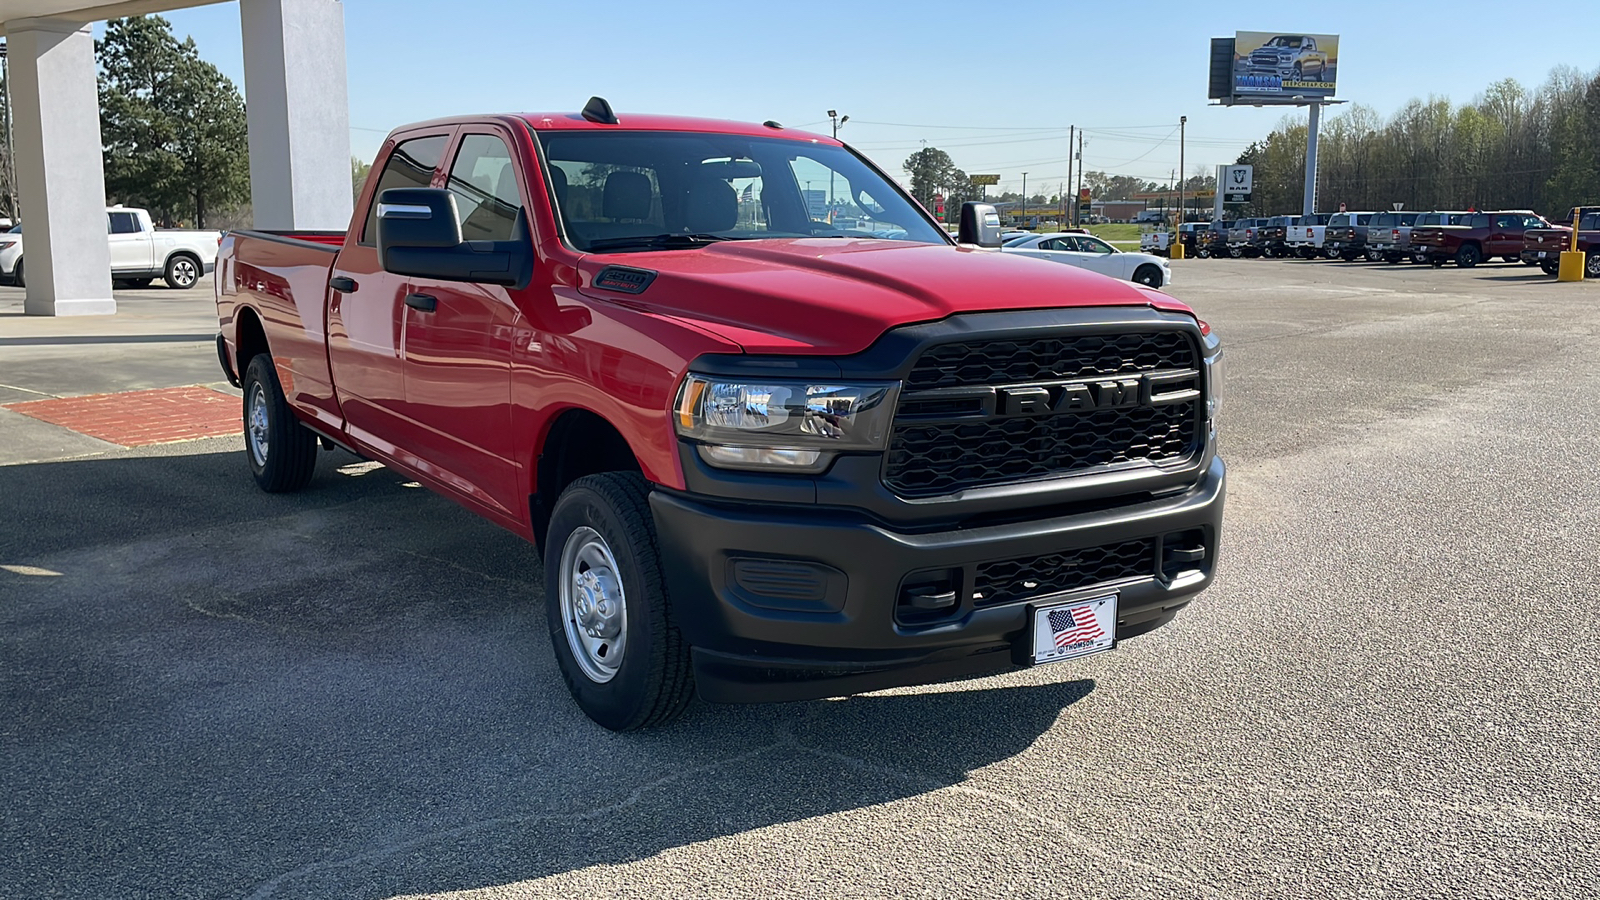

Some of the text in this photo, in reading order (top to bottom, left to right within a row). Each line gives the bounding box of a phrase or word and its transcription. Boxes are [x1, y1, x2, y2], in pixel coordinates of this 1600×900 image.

[1236, 75, 1282, 88] THOMSON
[604, 271, 643, 283] 2500
[1003, 379, 1140, 416] RAM
[1065, 640, 1095, 651] THOMSON
